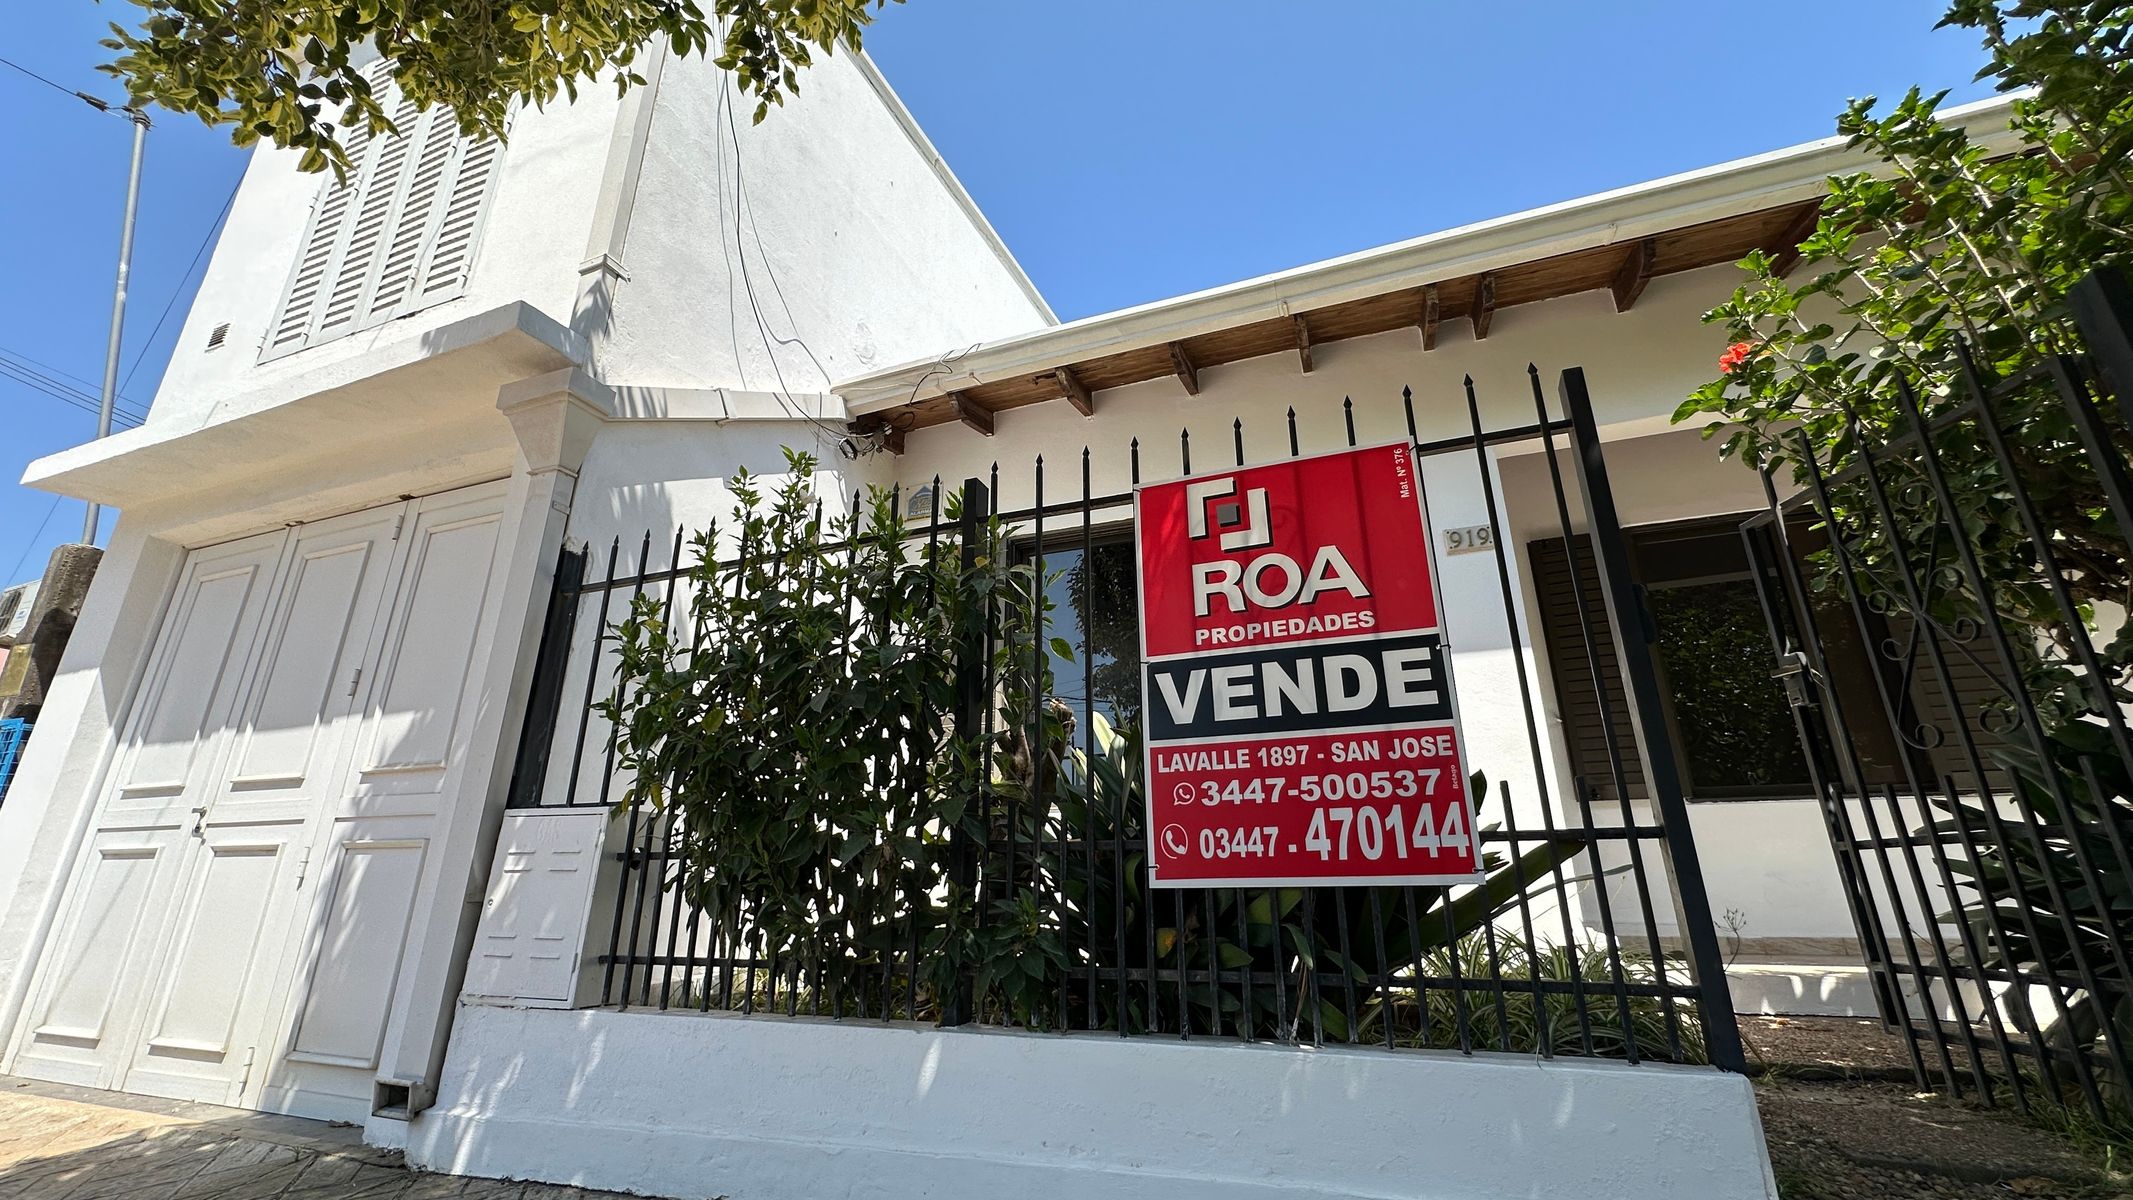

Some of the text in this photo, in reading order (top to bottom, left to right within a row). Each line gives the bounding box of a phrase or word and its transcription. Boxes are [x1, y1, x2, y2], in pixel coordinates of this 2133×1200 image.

[1393, 448, 1404, 464] 376
[1400, 478, 1410, 498] Mat.
[1450, 527, 1489, 548] 919
[1192, 545, 1371, 617] ROA
[1196, 610, 1376, 645] PROPIEDADES
[1154, 647, 1440, 725] VENDE
[1157, 749, 1250, 773] LAVALLE
[1257, 745, 1310, 768] 1897
[1331, 740, 1380, 763] SAN
[1388, 735, 1453, 760] JOSE
[1200, 768, 1441, 806] 3447-500537
[1200, 826, 1279, 859] 03447
[1305, 801, 1470, 861] 470144
